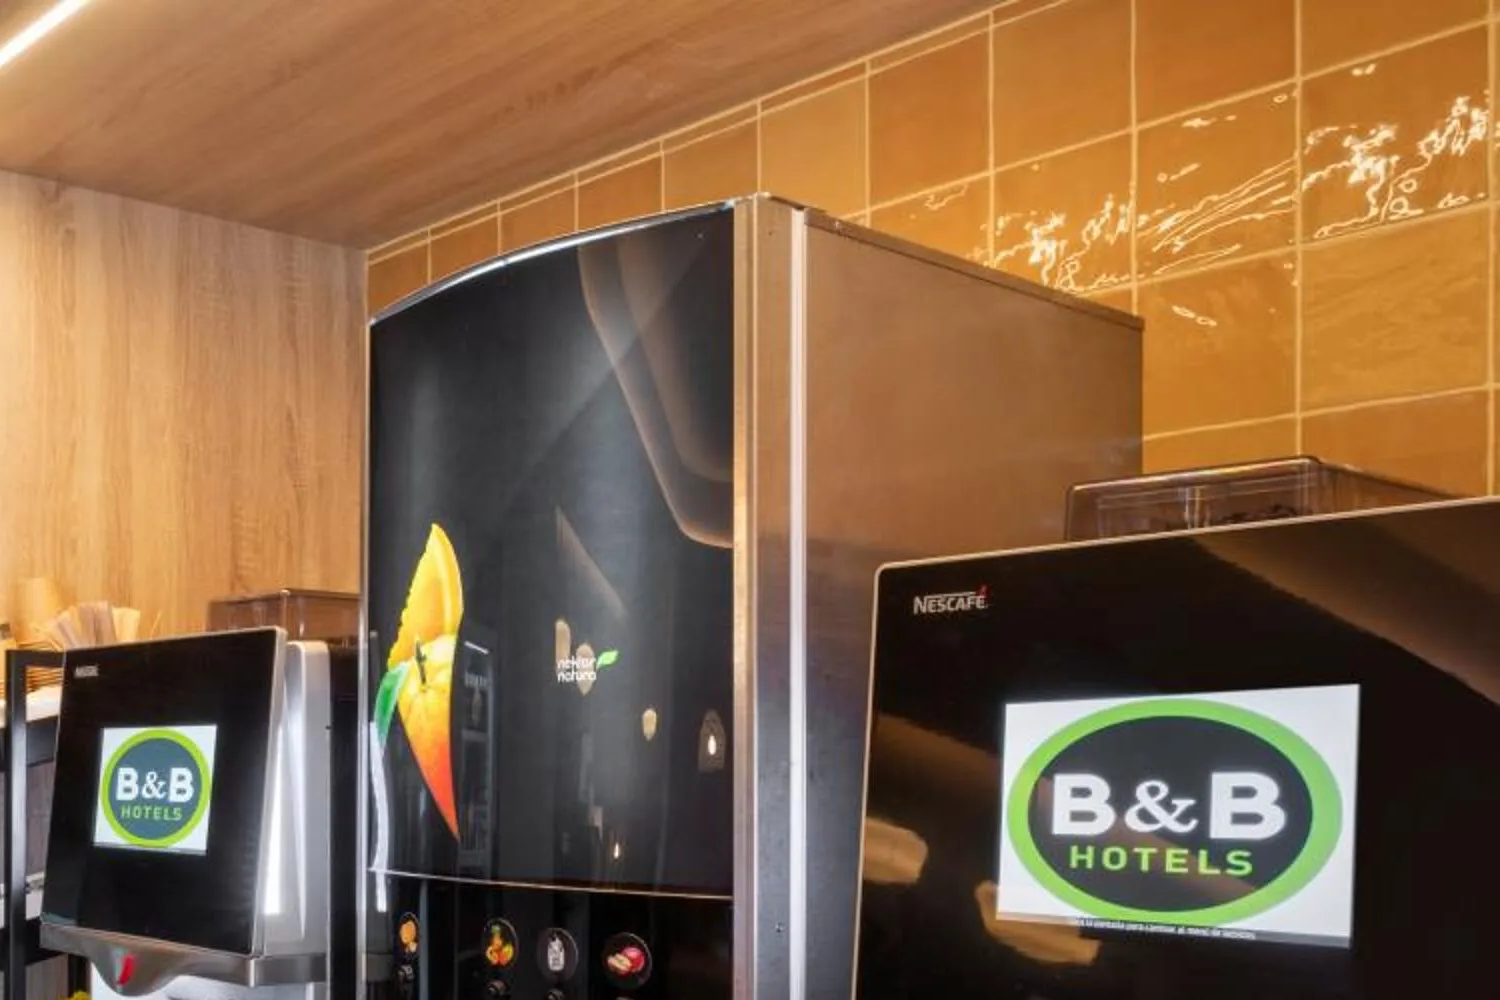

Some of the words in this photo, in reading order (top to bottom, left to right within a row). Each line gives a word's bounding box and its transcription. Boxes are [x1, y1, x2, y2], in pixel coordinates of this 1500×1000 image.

[115, 766, 195, 804] B&B
[121, 804, 183, 821] HOTELS
[1051, 770, 1287, 840] B&B
[1068, 844, 1254, 877] HOTELS
